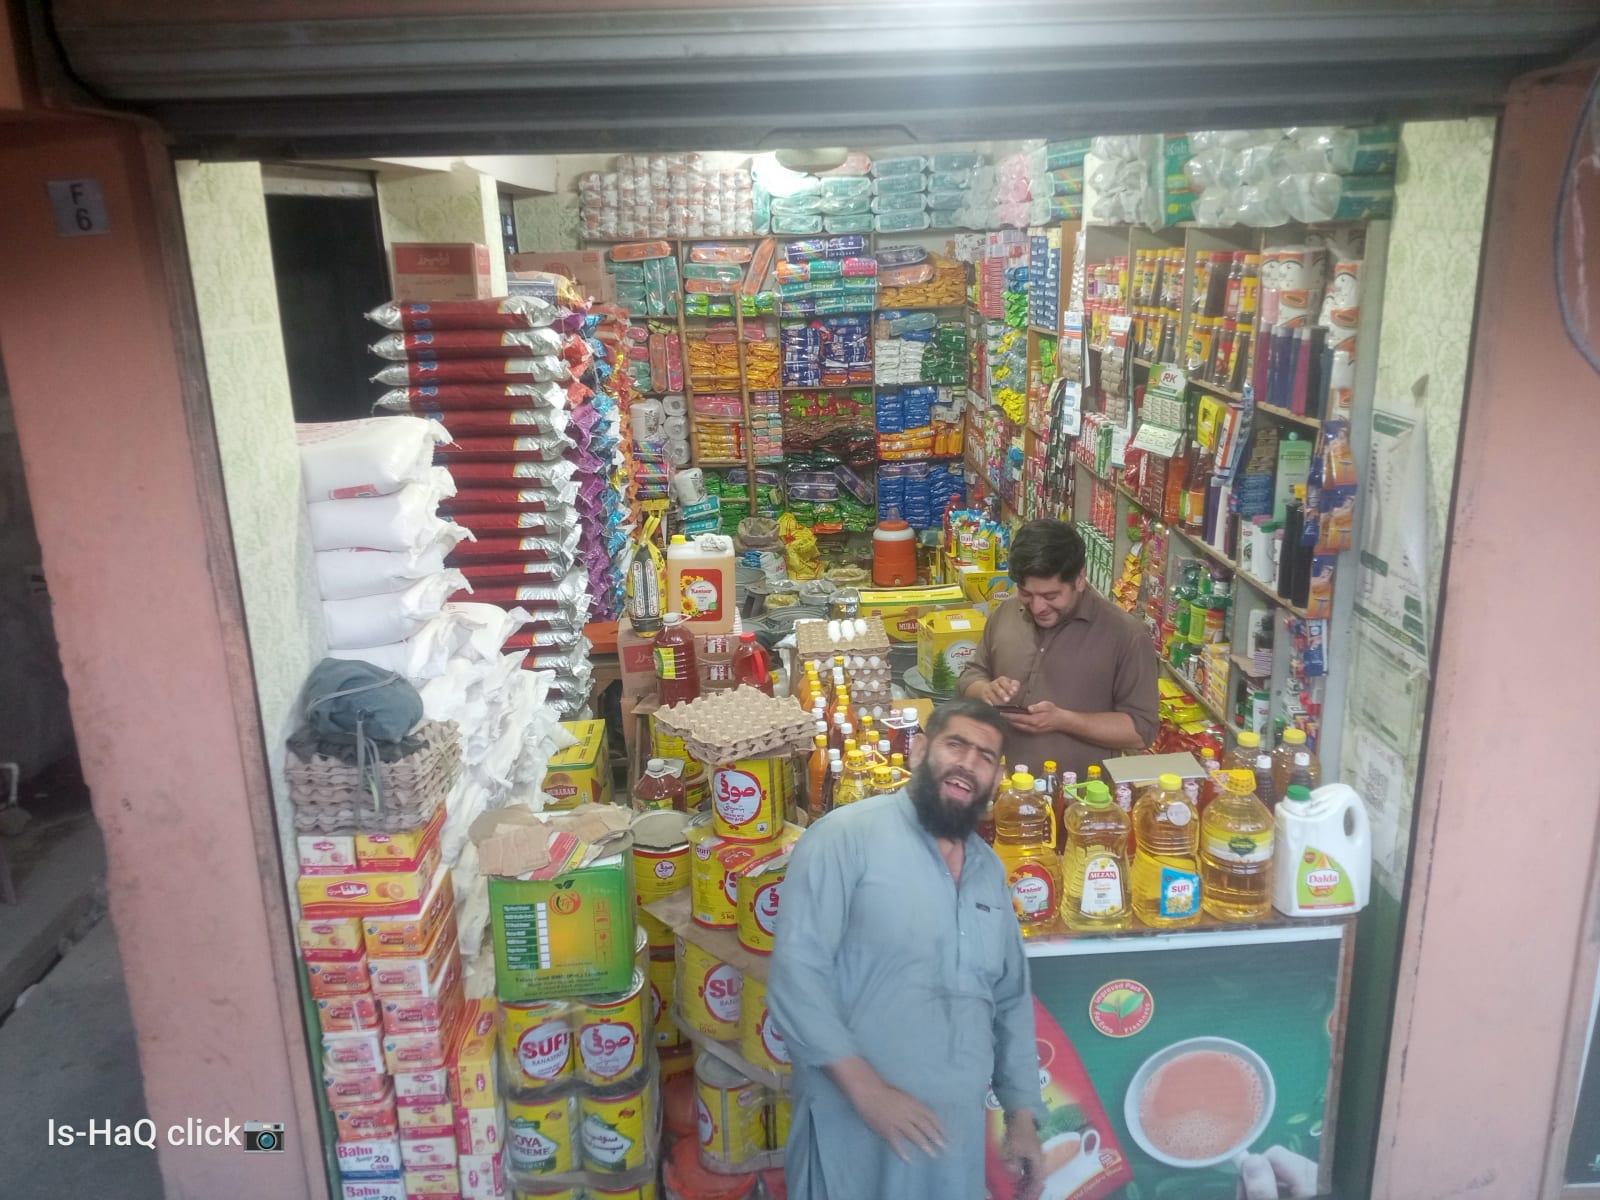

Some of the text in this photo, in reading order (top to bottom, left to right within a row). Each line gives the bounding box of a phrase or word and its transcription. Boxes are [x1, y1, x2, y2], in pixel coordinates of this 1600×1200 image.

[70, 183, 83, 205] F
[76, 208, 93, 231] 6
[1089, 871, 1116, 880] MEZAN
[1308, 873, 1338, 884] Dalda
[1171, 884, 1190, 893] SUFI
[522, 1031, 569, 1059] SUFI
[374, 1155, 389, 1163] 20
